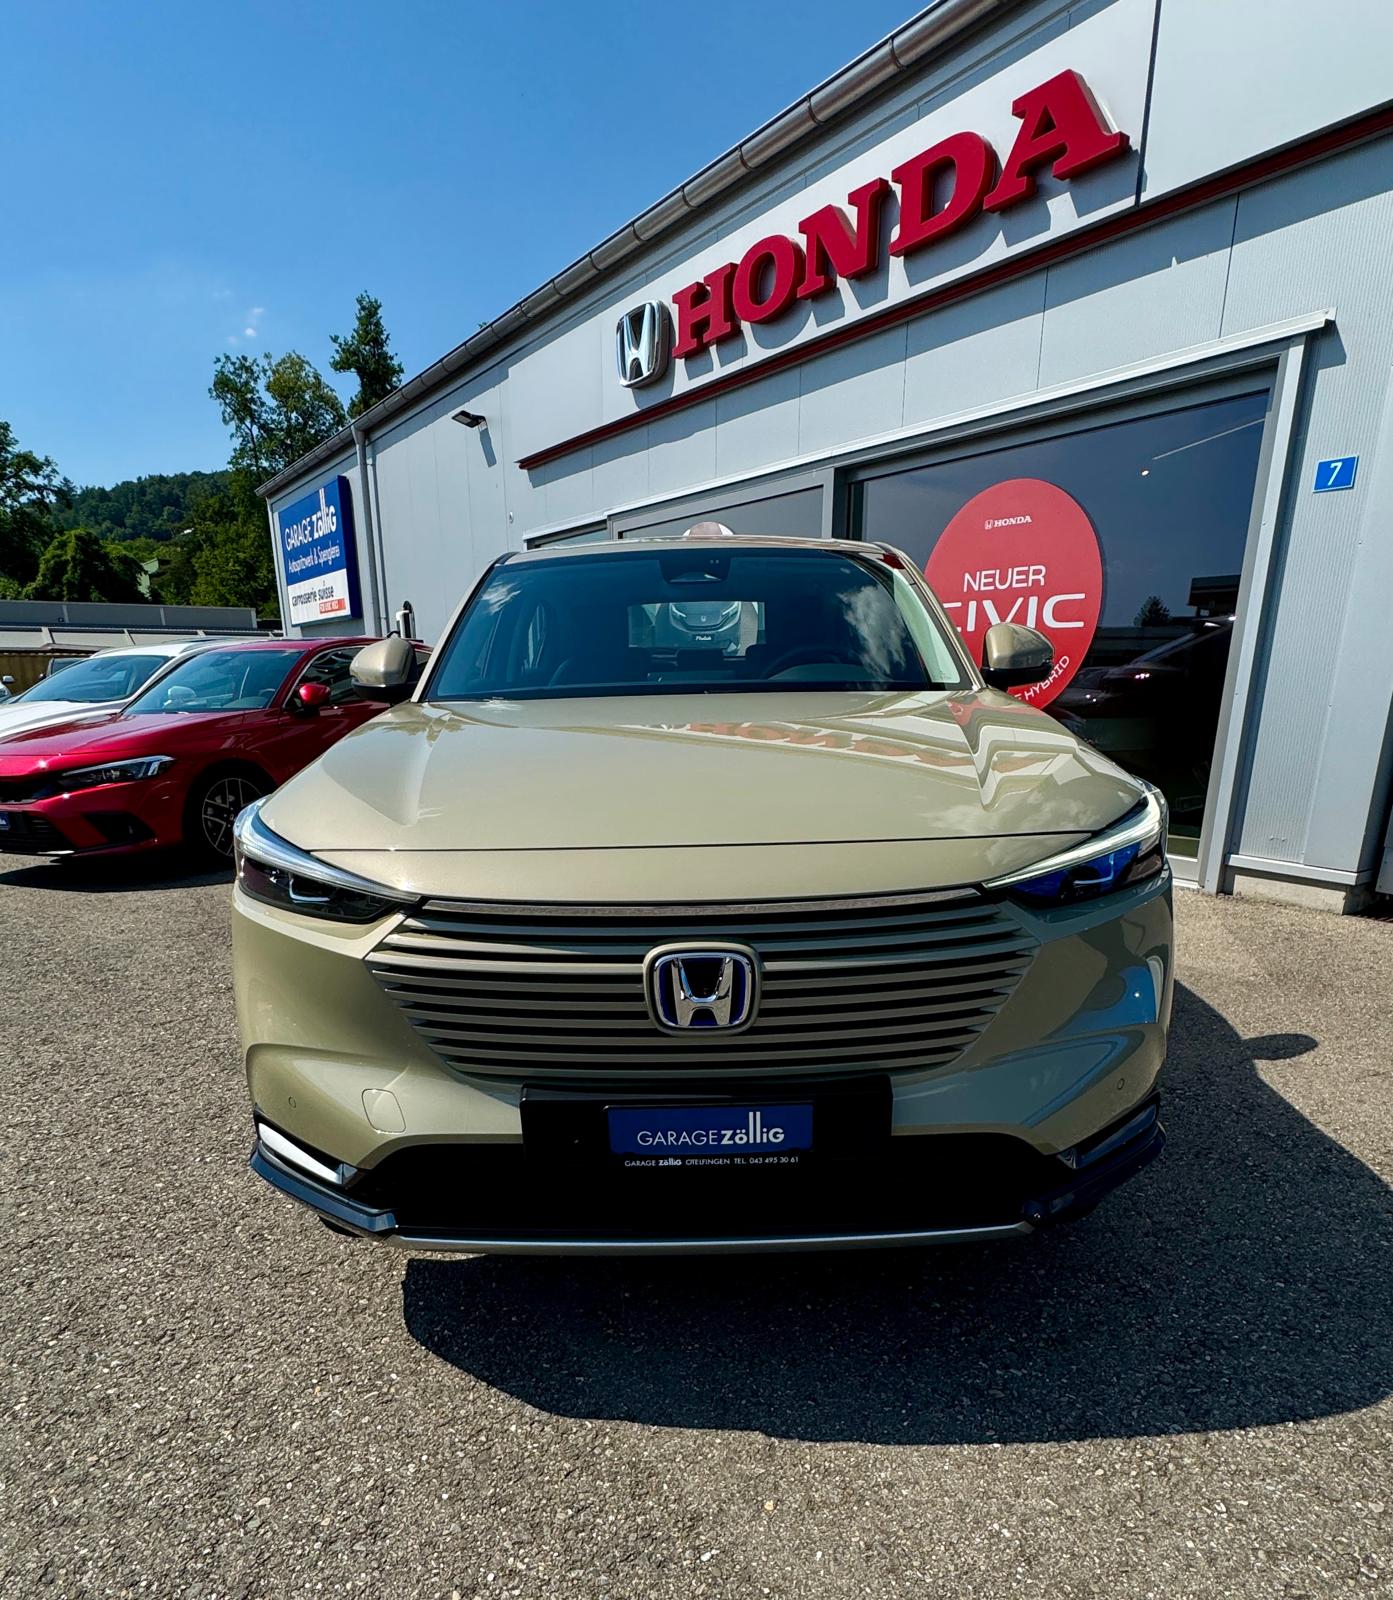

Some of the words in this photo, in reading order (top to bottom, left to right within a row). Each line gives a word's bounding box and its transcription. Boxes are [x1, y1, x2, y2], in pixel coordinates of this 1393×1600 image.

[672, 69, 1130, 359] HONDA
[1327, 461, 1343, 486] 7
[284, 517, 313, 551] GARAGE
[993, 515, 1032, 528] HONDA
[963, 564, 1047, 593] NEUER
[637, 1130, 719, 1146] GARAGE
[685, 1158, 730, 1166] OTELFINGEN
[764, 1156, 778, 1164] 495
[779, 1156, 789, 1164] 30
